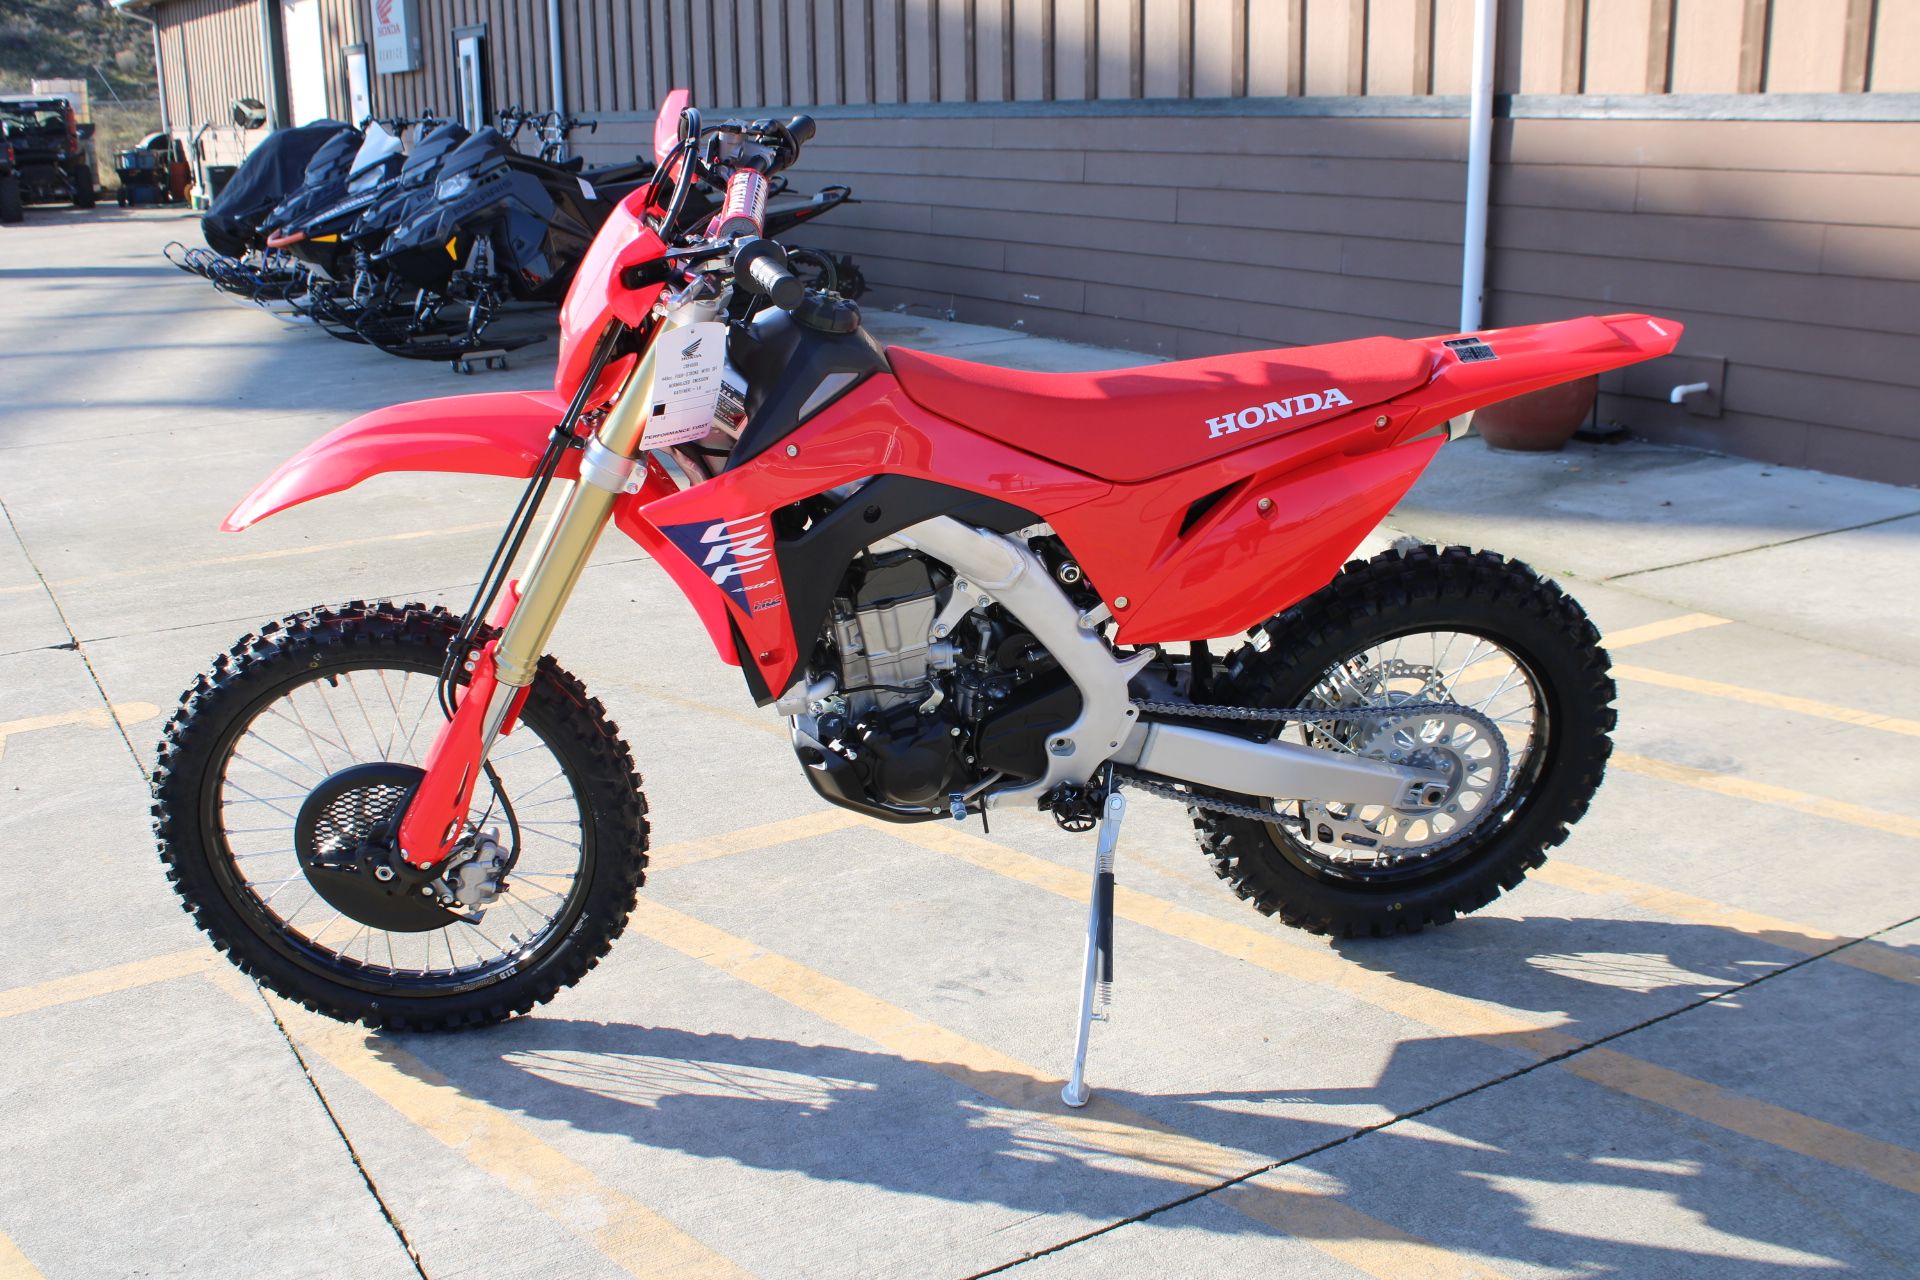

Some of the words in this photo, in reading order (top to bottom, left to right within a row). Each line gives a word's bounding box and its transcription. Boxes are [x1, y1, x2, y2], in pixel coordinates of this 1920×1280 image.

[377, 24, 400, 37] HONDA
[454, 180, 513, 216] POLARIS
[727, 172, 751, 217] RENTHAL
[681, 353, 702, 361] HONDA
[644, 427, 691, 440] PERFORMANCE
[691, 422, 709, 431] FIRST
[1205, 387, 1353, 439] HONDA
[699, 511, 772, 586] CRF
